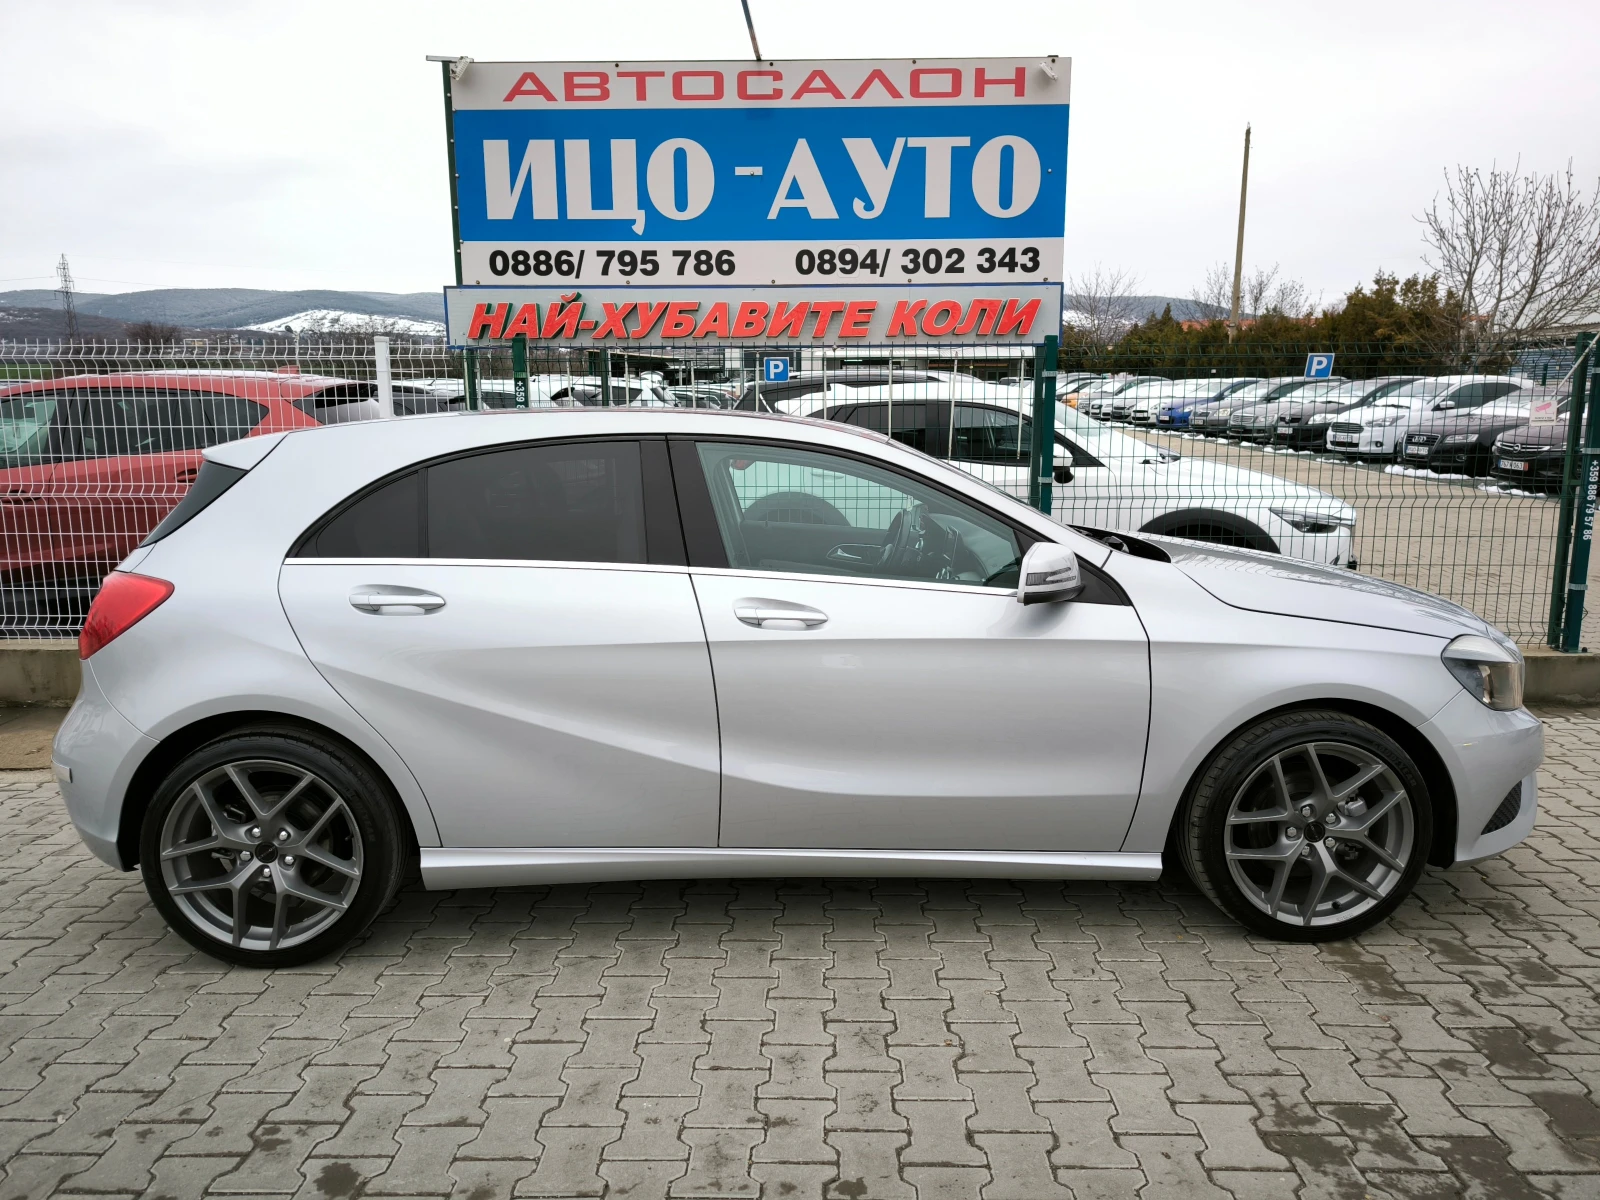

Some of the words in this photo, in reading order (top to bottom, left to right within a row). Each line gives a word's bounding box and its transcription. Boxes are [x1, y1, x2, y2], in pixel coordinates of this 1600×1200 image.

[504, 67, 1027, 103] АВТОСАЛОН
[488, 249, 586, 279] 0886/
[596, 249, 660, 277] 795
[672, 249, 736, 277] 786
[795, 248, 891, 278] 0894/
[900, 247, 965, 275] 302
[976, 246, 1041, 274] 343
[466, 292, 878, 340] НАЙ-ХУБАВИТЕ
[886, 298, 1043, 337] КОЛИ
[769, 360, 784, 379] P
[1310, 356, 1328, 376] P
[516, 380, 525, 402] +359
[1589, 460, 1599, 482] +359
[1587, 484, 1597, 501] 886
[1585, 503, 1595, 514] 79
[1584, 516, 1593, 527] 57
[1582, 529, 1592, 541] 86
